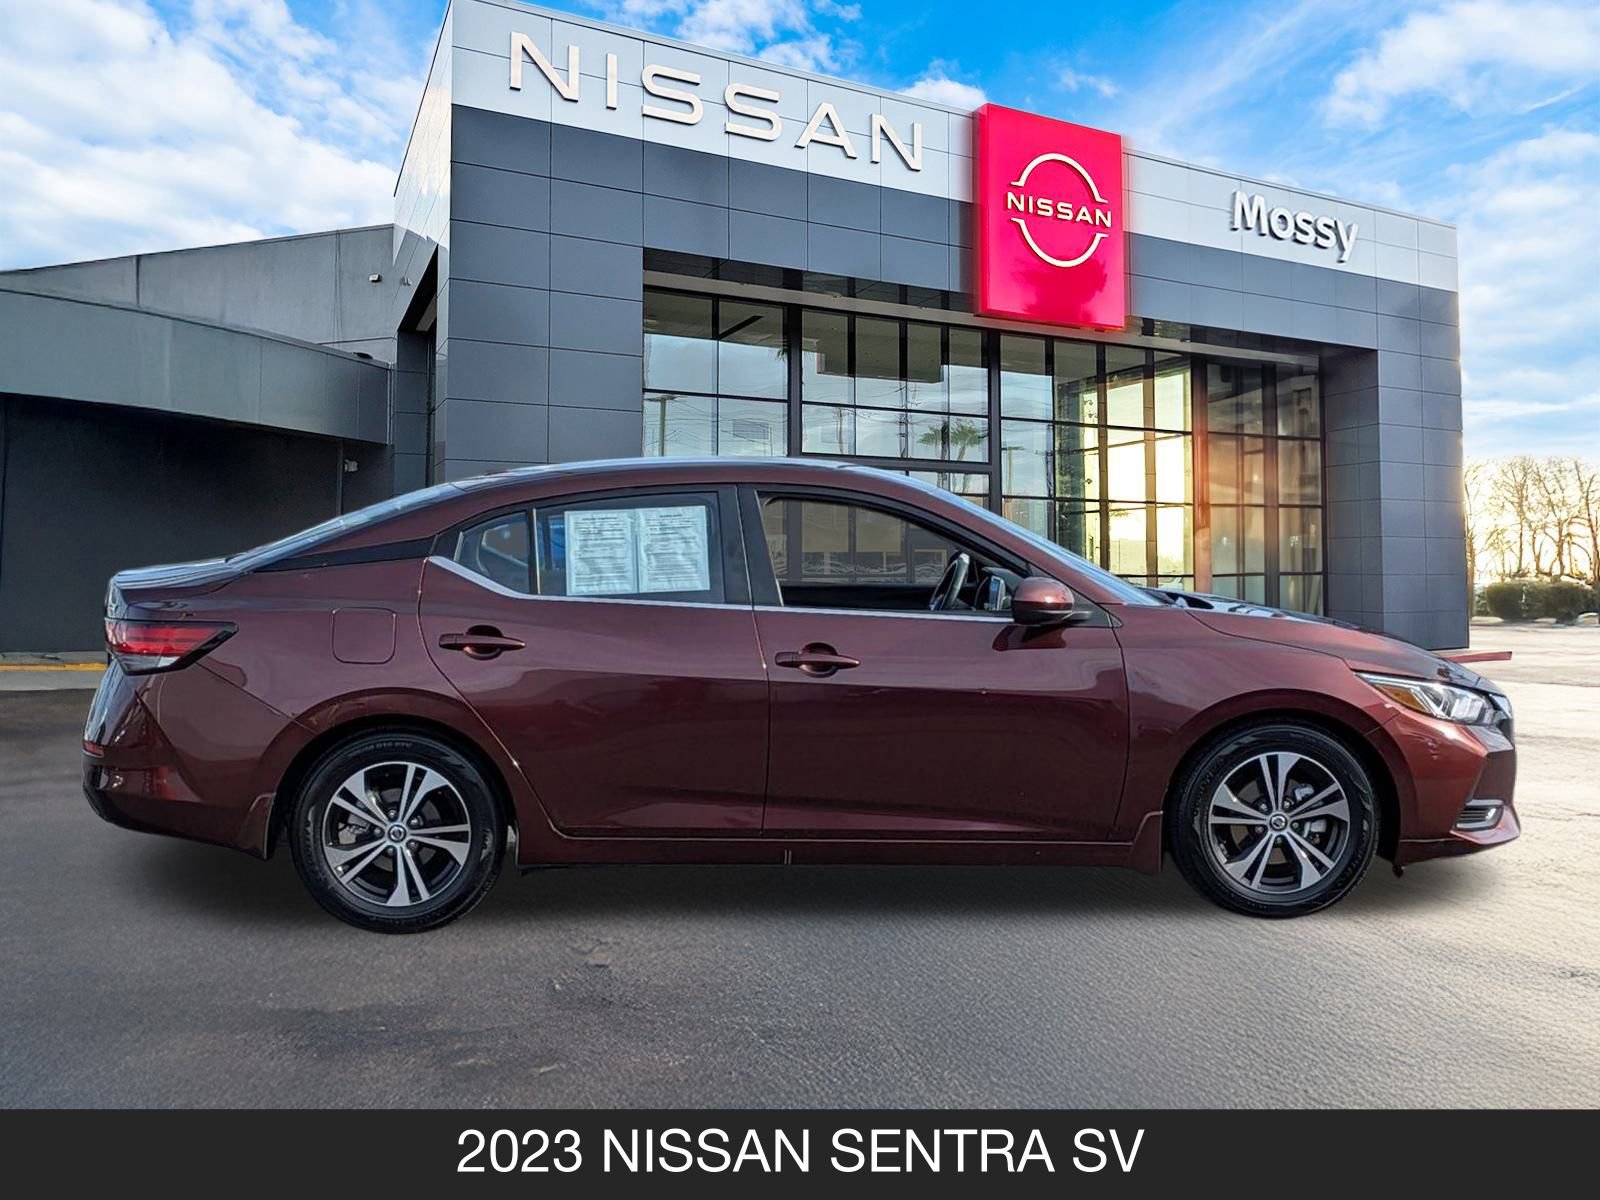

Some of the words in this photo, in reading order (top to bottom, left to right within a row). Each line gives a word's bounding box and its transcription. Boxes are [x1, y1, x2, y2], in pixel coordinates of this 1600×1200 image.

[509, 31, 923, 172] NISSAN
[1006, 191, 1112, 228] NISSAN
[1231, 190, 1359, 263] Mossy
